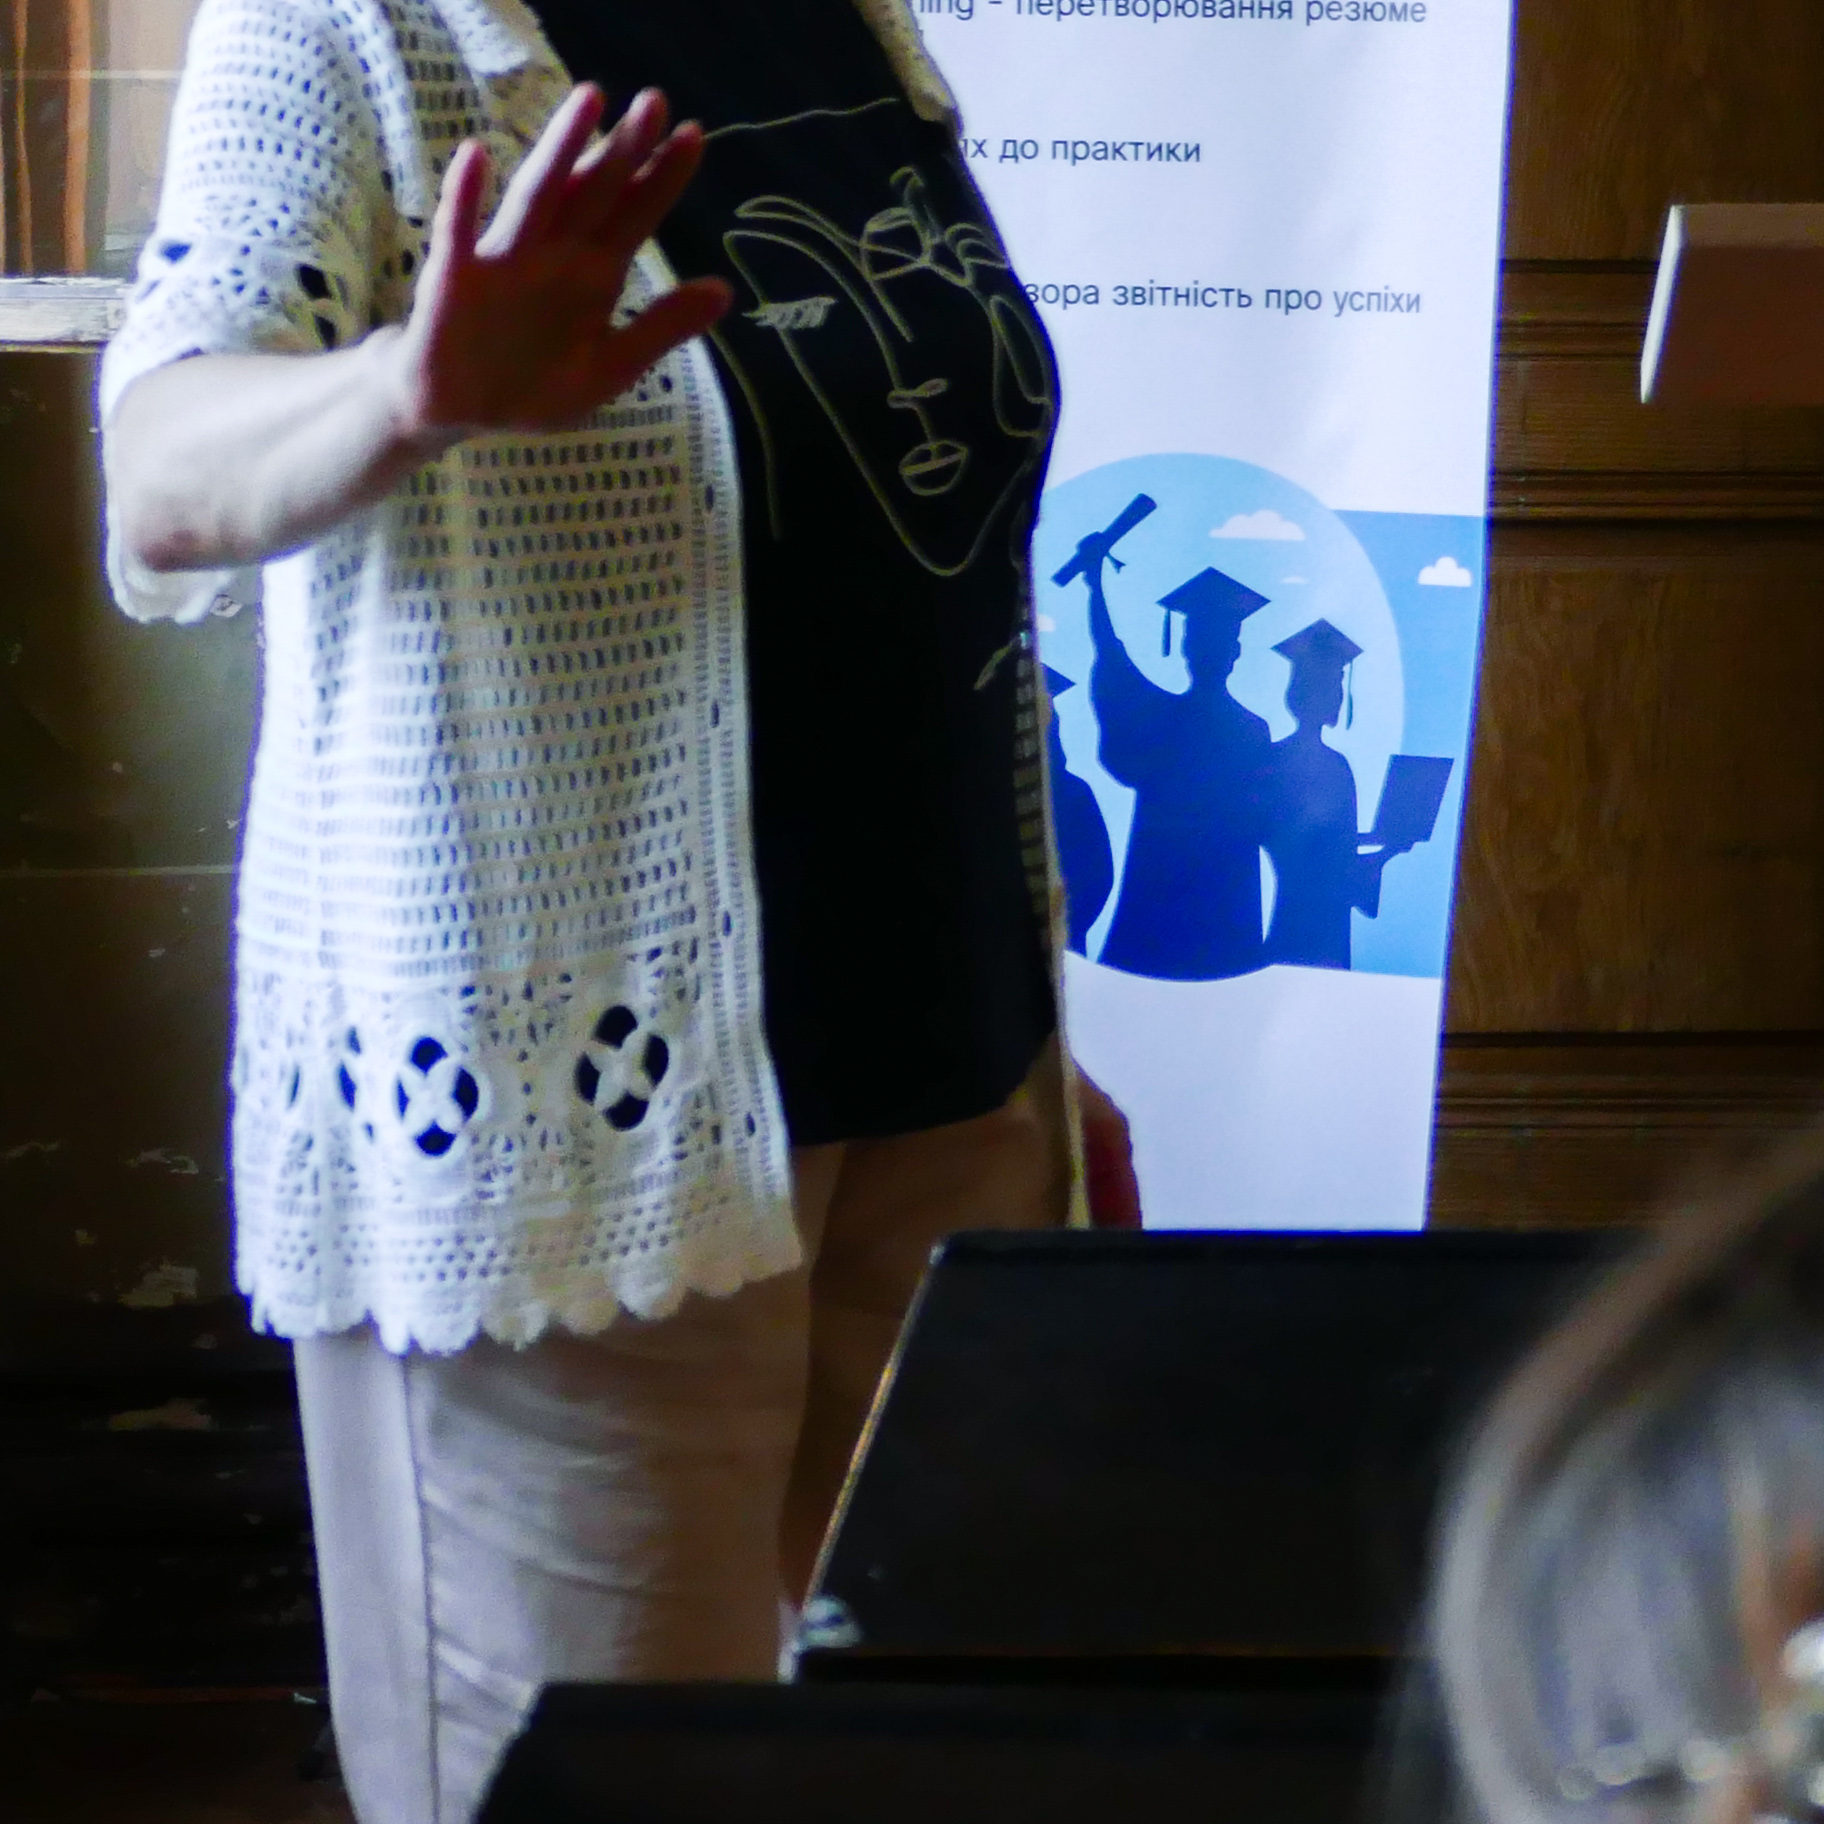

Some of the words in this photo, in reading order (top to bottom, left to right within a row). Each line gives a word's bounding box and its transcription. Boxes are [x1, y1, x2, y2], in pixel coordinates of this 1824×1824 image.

[1305, 0, 1426, 27] резюме
[999, 138, 1039, 164] до
[1051, 139, 1201, 166] практики
[1112, 278, 1253, 309] звітність
[1264, 288, 1322, 316] про
[1332, 285, 1421, 319] успіхи
